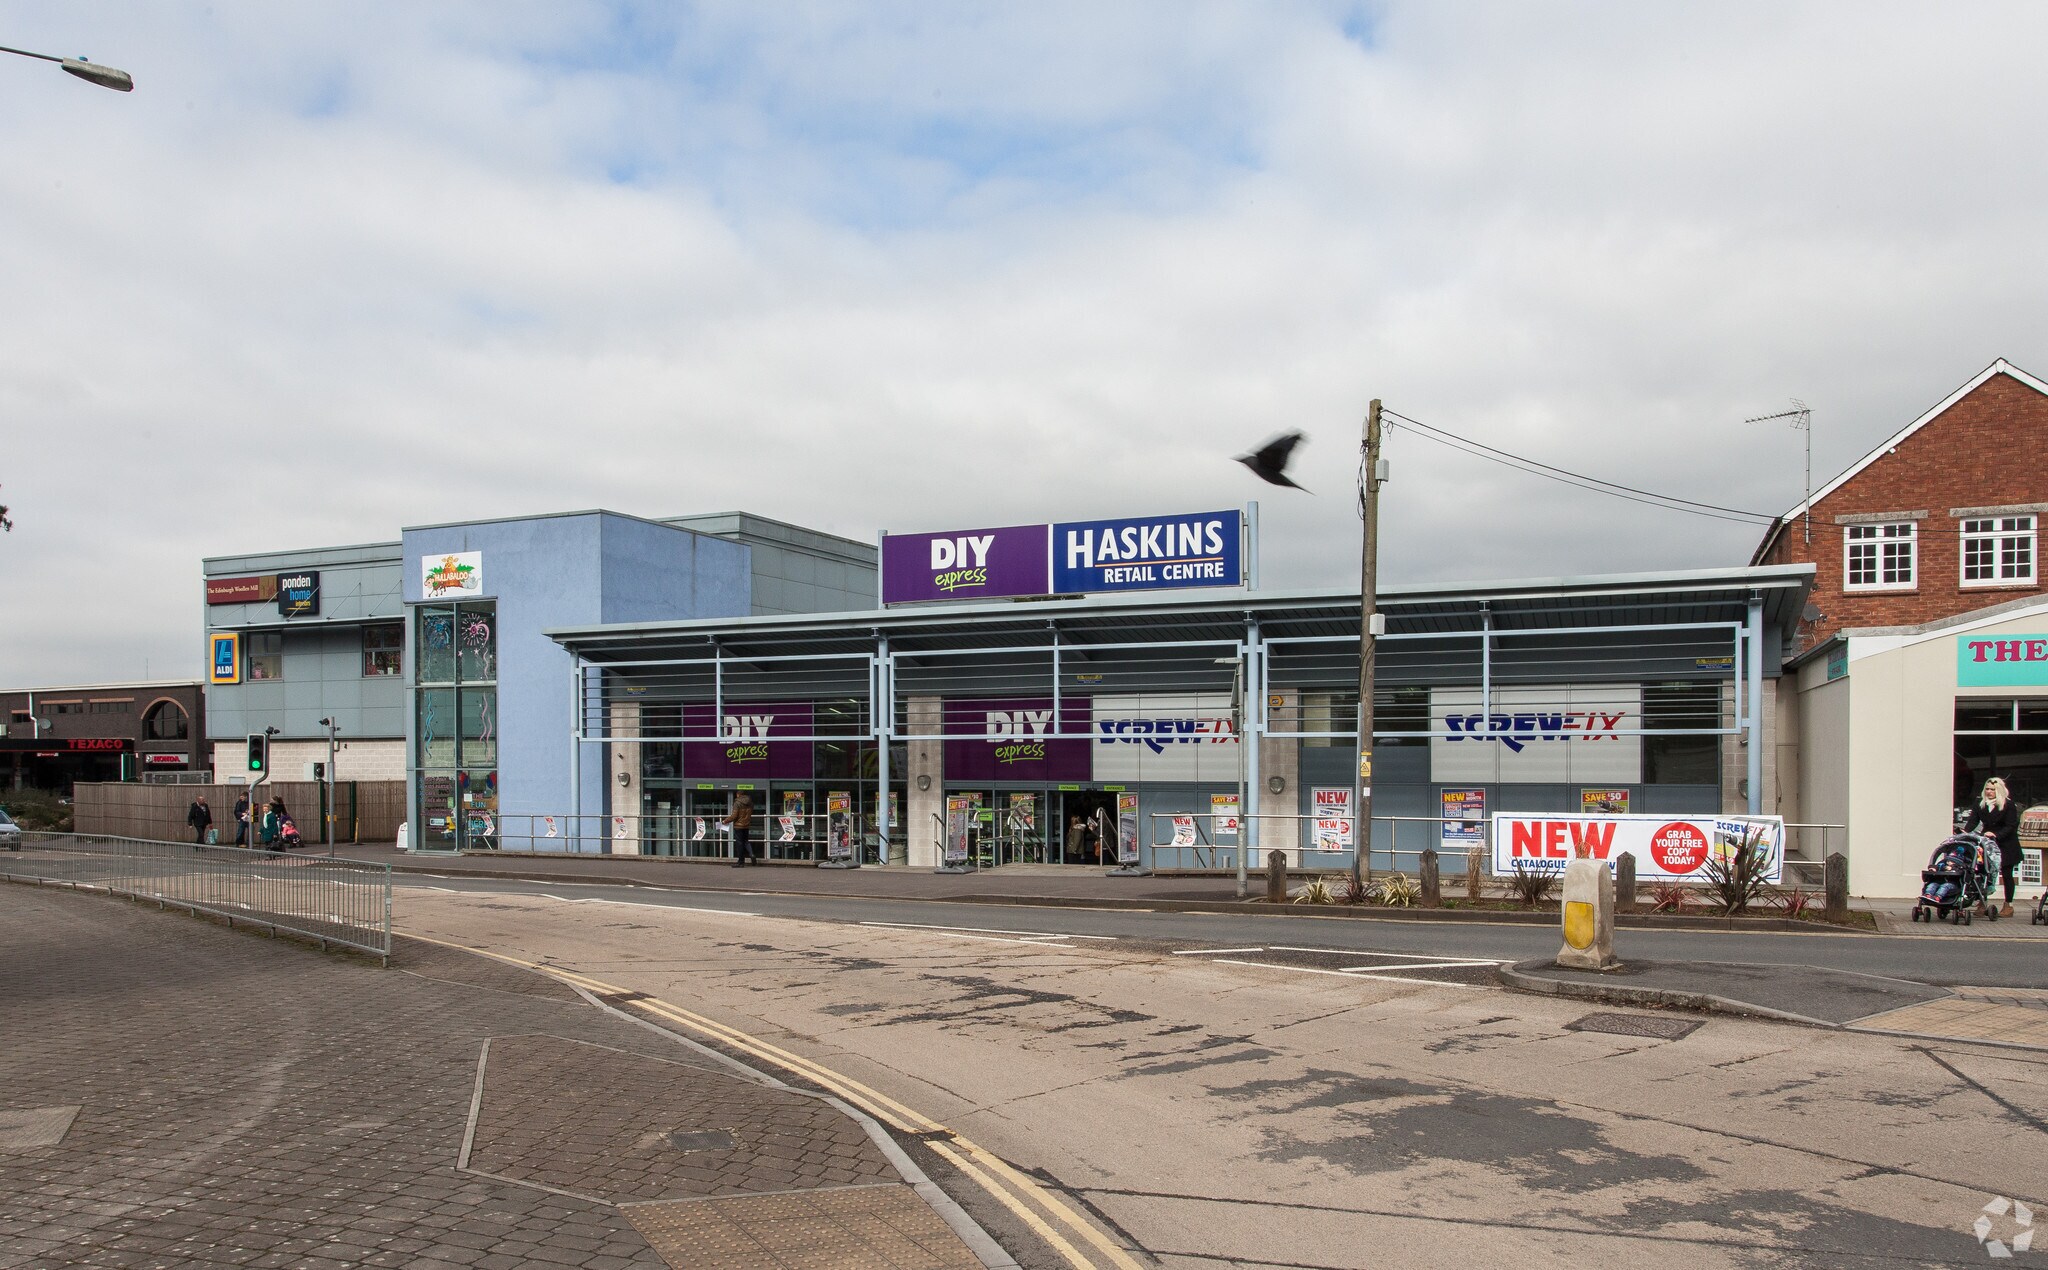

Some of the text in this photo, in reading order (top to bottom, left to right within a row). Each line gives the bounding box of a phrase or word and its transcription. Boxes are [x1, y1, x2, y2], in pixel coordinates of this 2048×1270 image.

[1067, 520, 1224, 569] HASKINS
[931, 535, 995, 570] DIY
[1104, 561, 1225, 583] RETAIL CENTRE
[282, 575, 311, 591] ponden
[935, 567, 987, 593] express
[289, 589, 311, 600] home
[1968, 639, 2048, 663] THE
[216, 666, 233, 674] ALDI
[719, 715, 775, 744] DIY
[987, 710, 1053, 743] DIY
[1444, 711, 1626, 754] SCREWFIX
[1100, 717, 1240, 755] SCREWFIX
[67, 739, 124, 749] TEXACO
[152, 755, 181, 763] HONDA
[726, 744, 769, 764] express
[995, 743, 1045, 765] express
[1316, 791, 1348, 804] NEW
[1444, 792, 1466, 802] NEW
[1585, 793, 1607, 802] SAVE
[1174, 817, 1191, 825] NEW
[1318, 820, 1338, 829] NEW
[1512, 821, 1617, 860] NEW
[1666, 830, 1692, 839] GRAB
[1655, 838, 1703, 848] YOUR FREE
[1667, 847, 1691, 856] COPY
[1511, 859, 1567, 869] CATALOGUE
[1662, 855, 1696, 865] TODAY!
